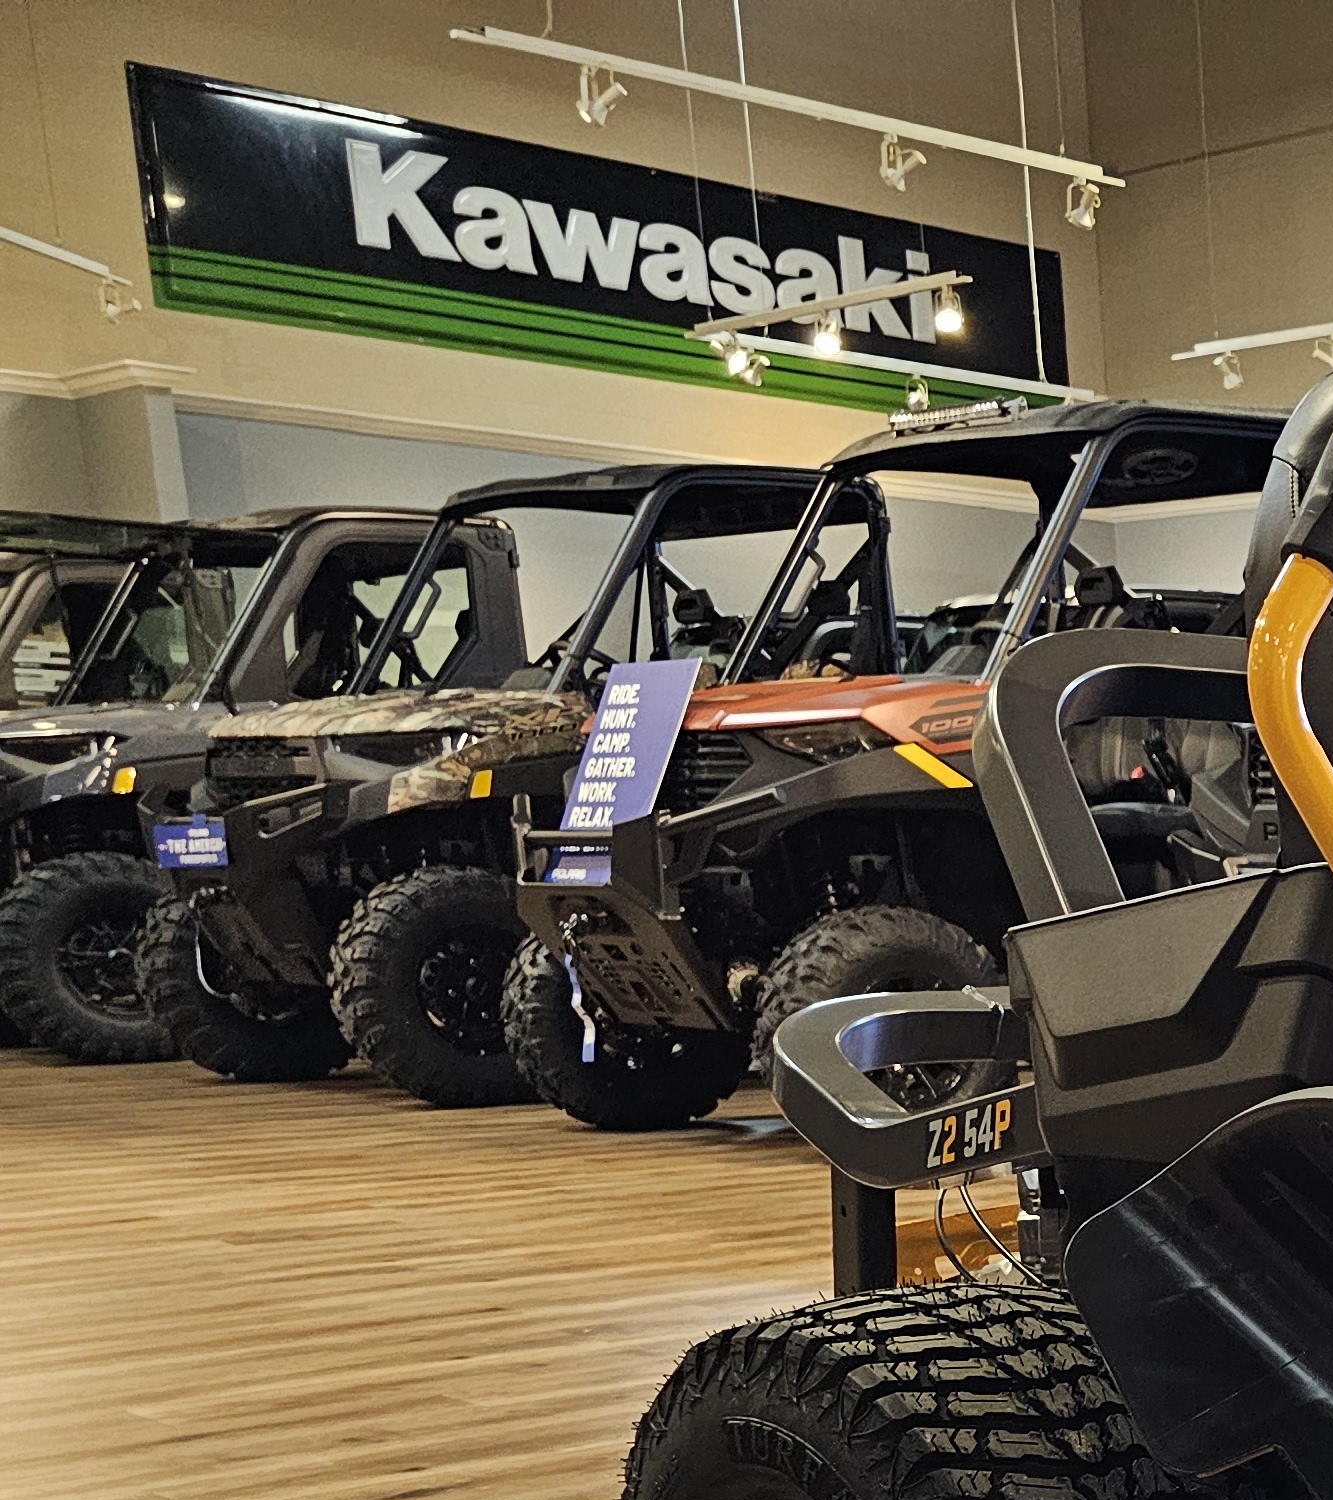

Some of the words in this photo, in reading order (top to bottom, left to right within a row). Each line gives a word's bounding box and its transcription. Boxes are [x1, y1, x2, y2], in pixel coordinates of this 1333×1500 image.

[345, 138, 937, 344] Kawasaki
[607, 683, 640, 705] RIDE.
[600, 708, 638, 730] HUNT.
[921, 715, 977, 734] 100
[592, 732, 630, 754] CAMP.
[584, 757, 636, 779] GATHER.
[577, 782, 617, 803] WORK.
[568, 806, 614, 828] RELAX.
[927, 1115, 957, 1169] Z2
[963, 1098, 1011, 1158] 54P
